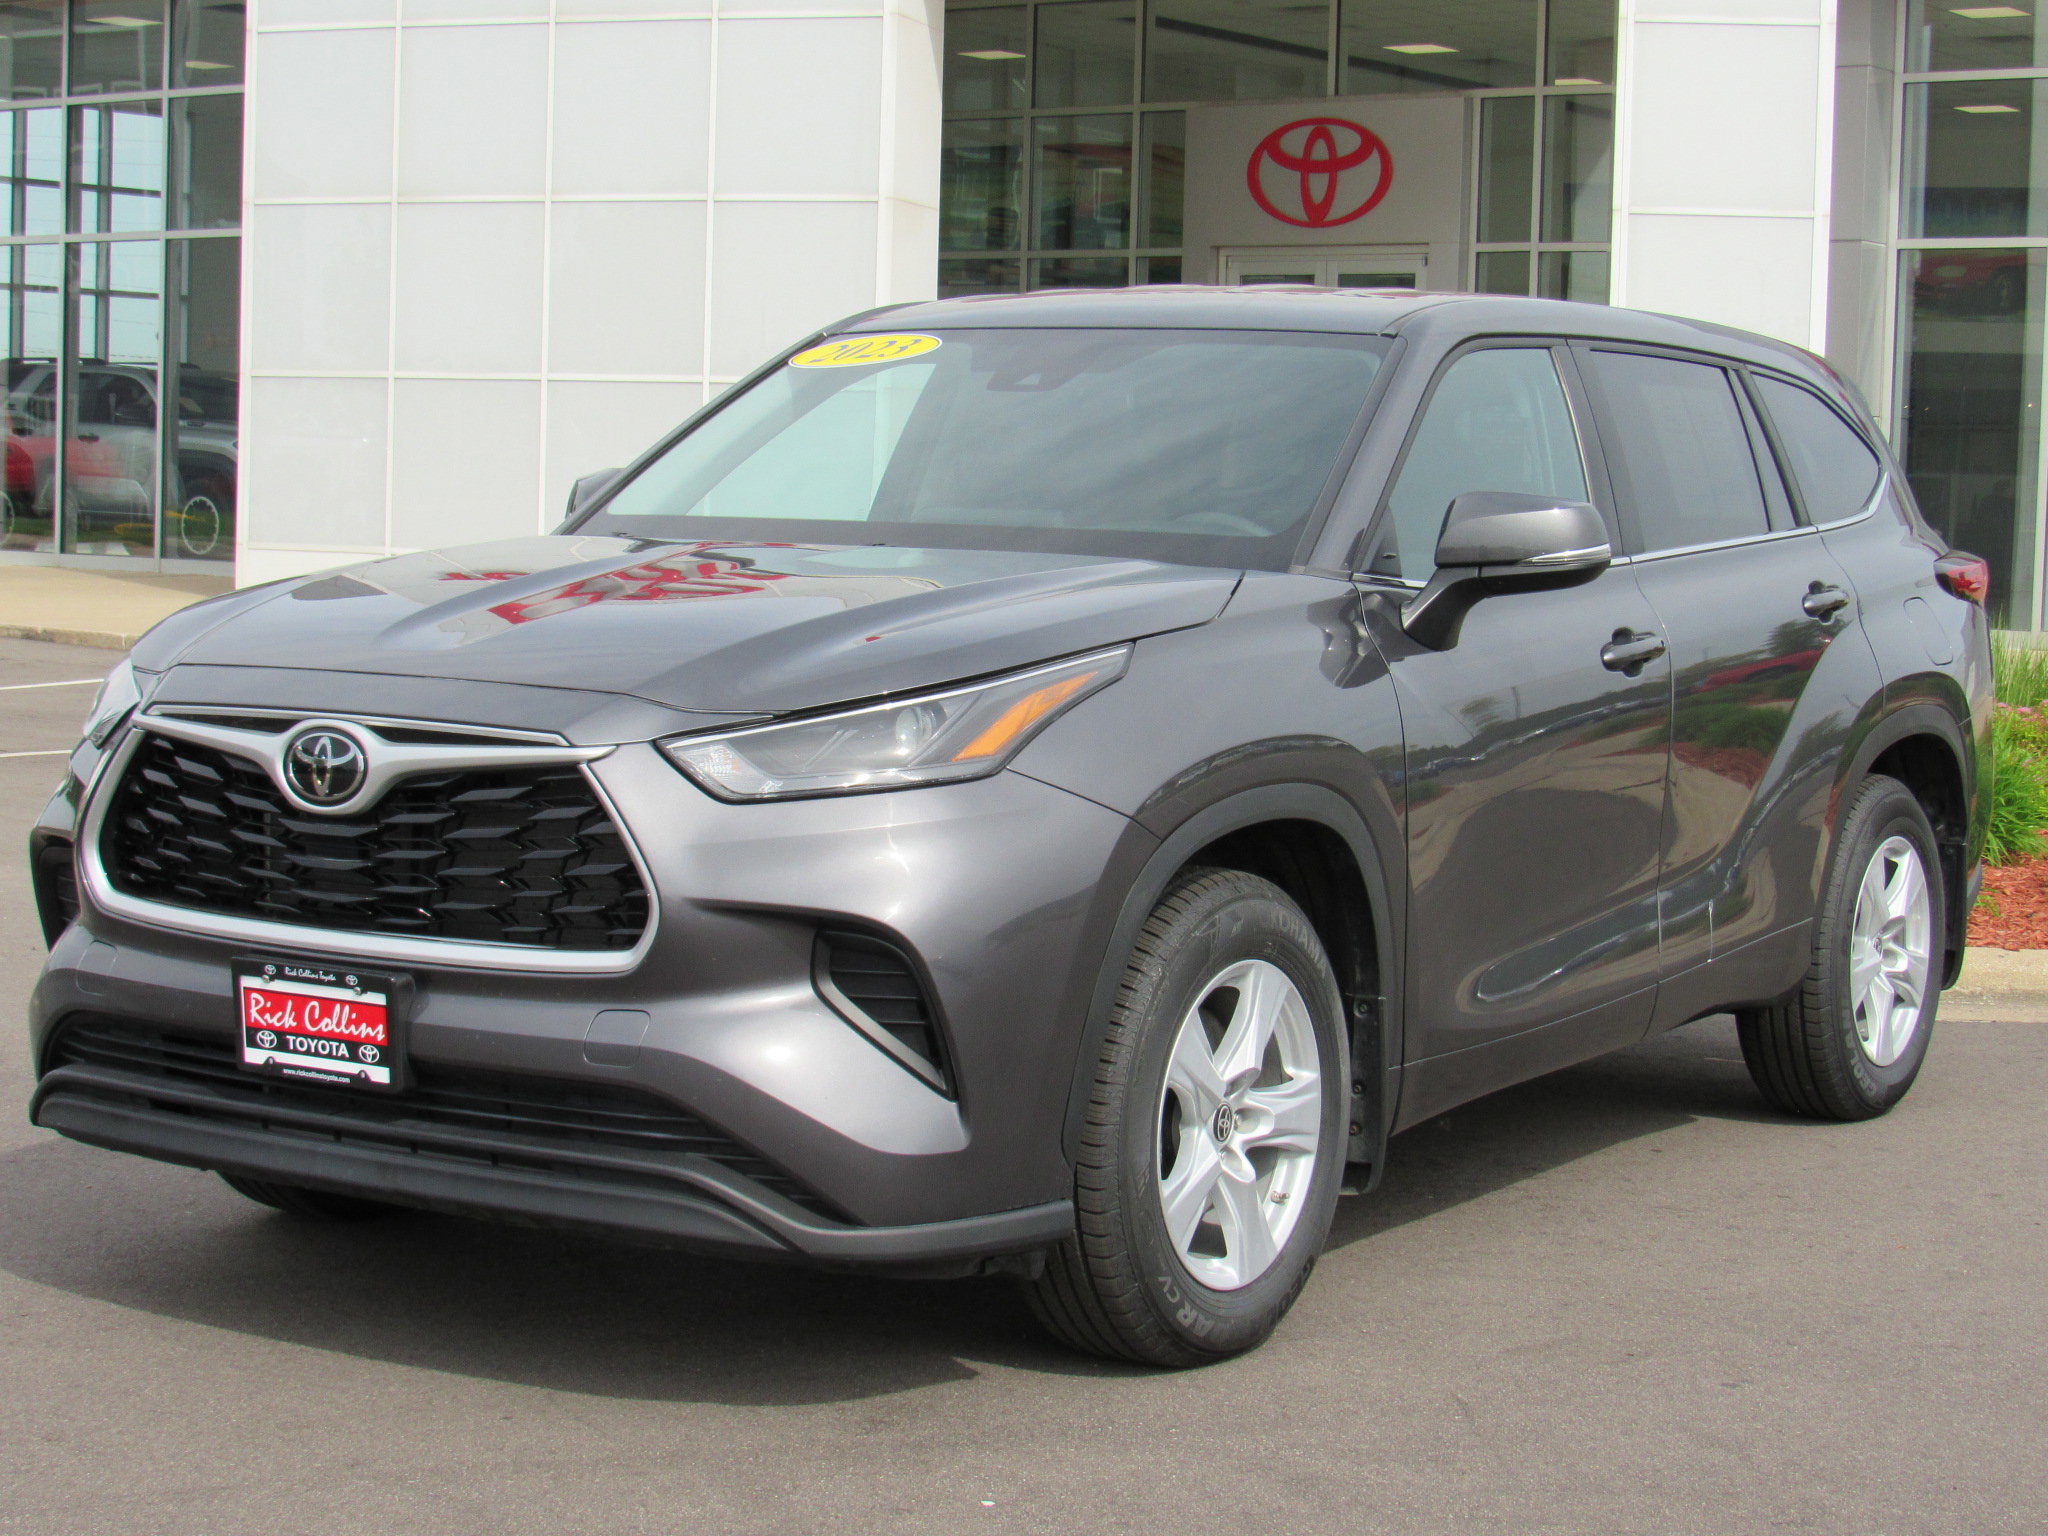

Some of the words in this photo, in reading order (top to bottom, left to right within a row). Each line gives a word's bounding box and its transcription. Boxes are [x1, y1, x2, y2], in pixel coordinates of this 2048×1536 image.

[807, 338, 922, 364] 2023
[285, 966, 297, 976] Rick
[298, 967, 318, 979] Collins
[319, 970, 336, 982] Toyota
[250, 993, 297, 1028] Rick
[304, 1000, 386, 1042] Collins
[285, 1034, 350, 1058] TOYOTA
[283, 1068, 350, 1083] www.rickcollinstoyota.com
